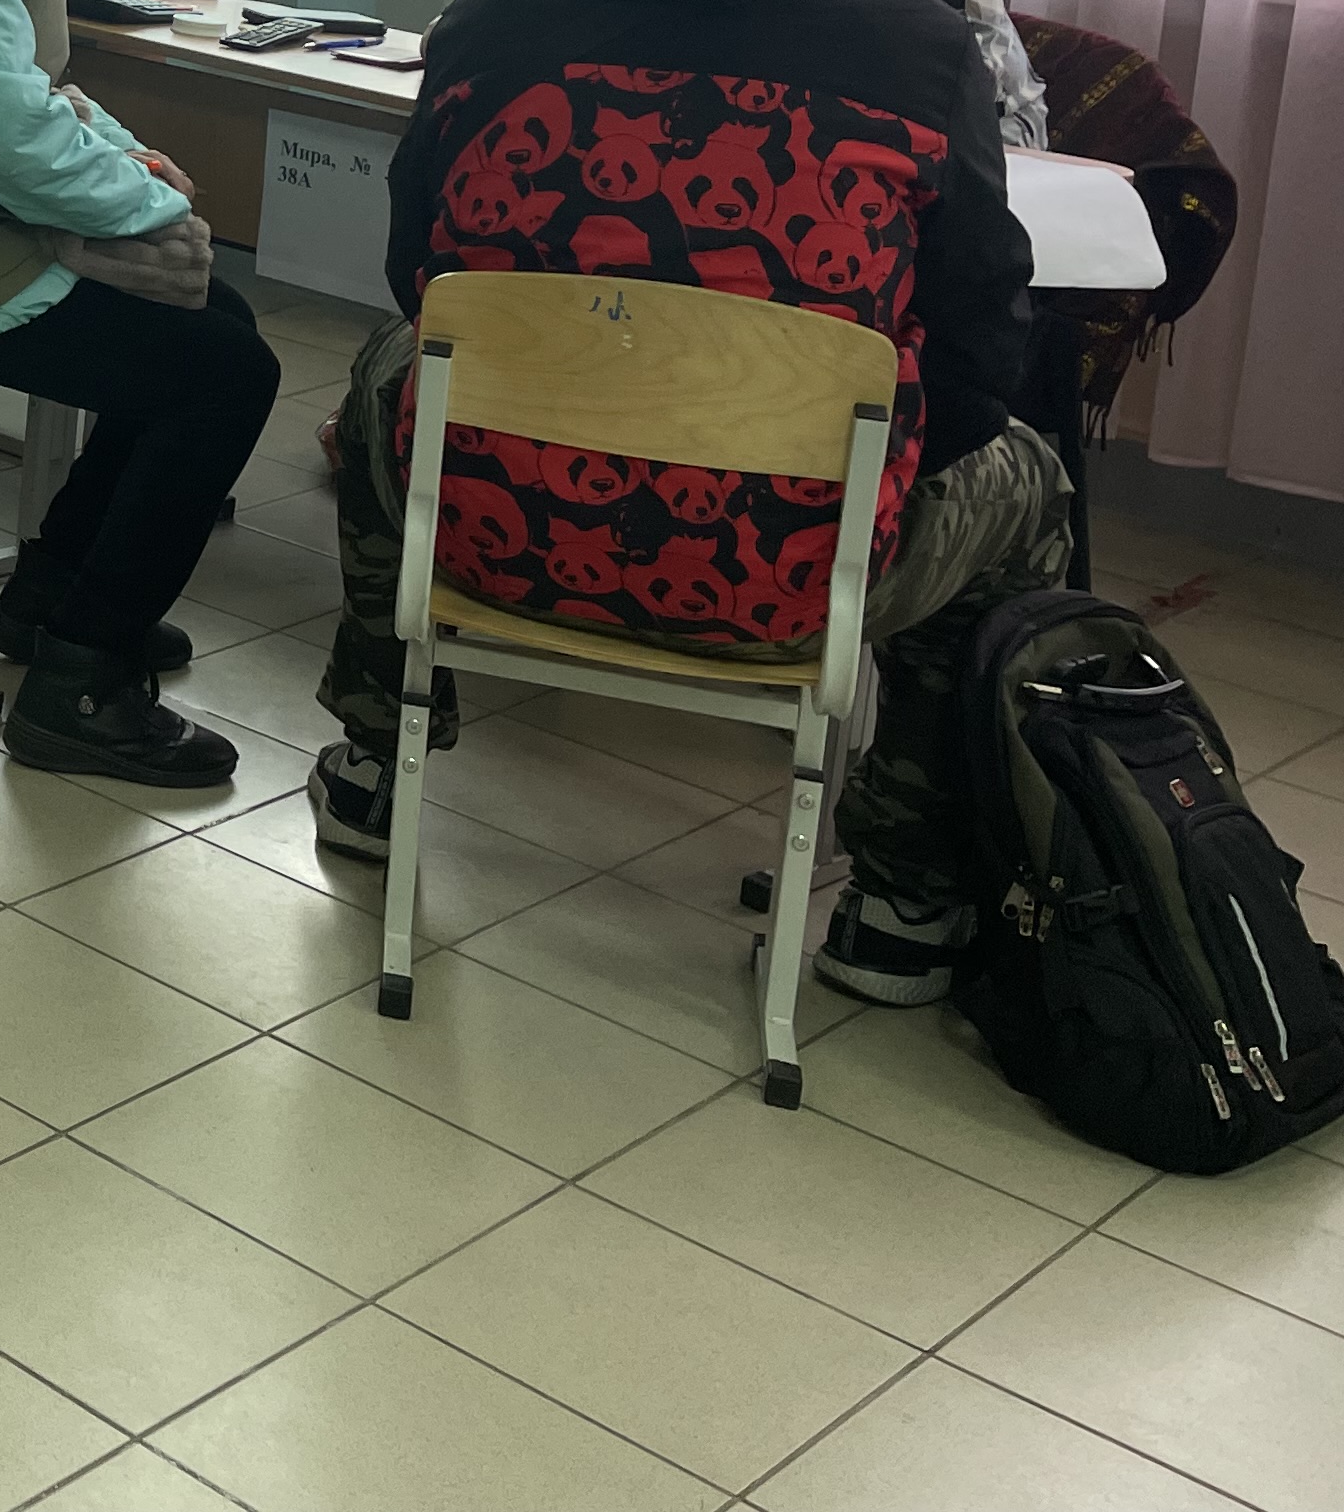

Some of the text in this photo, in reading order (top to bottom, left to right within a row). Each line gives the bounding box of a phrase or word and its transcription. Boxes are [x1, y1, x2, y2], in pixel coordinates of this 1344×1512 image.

[281, 139, 371, 176] Мира, №
[277, 165, 312, 189] 38А
